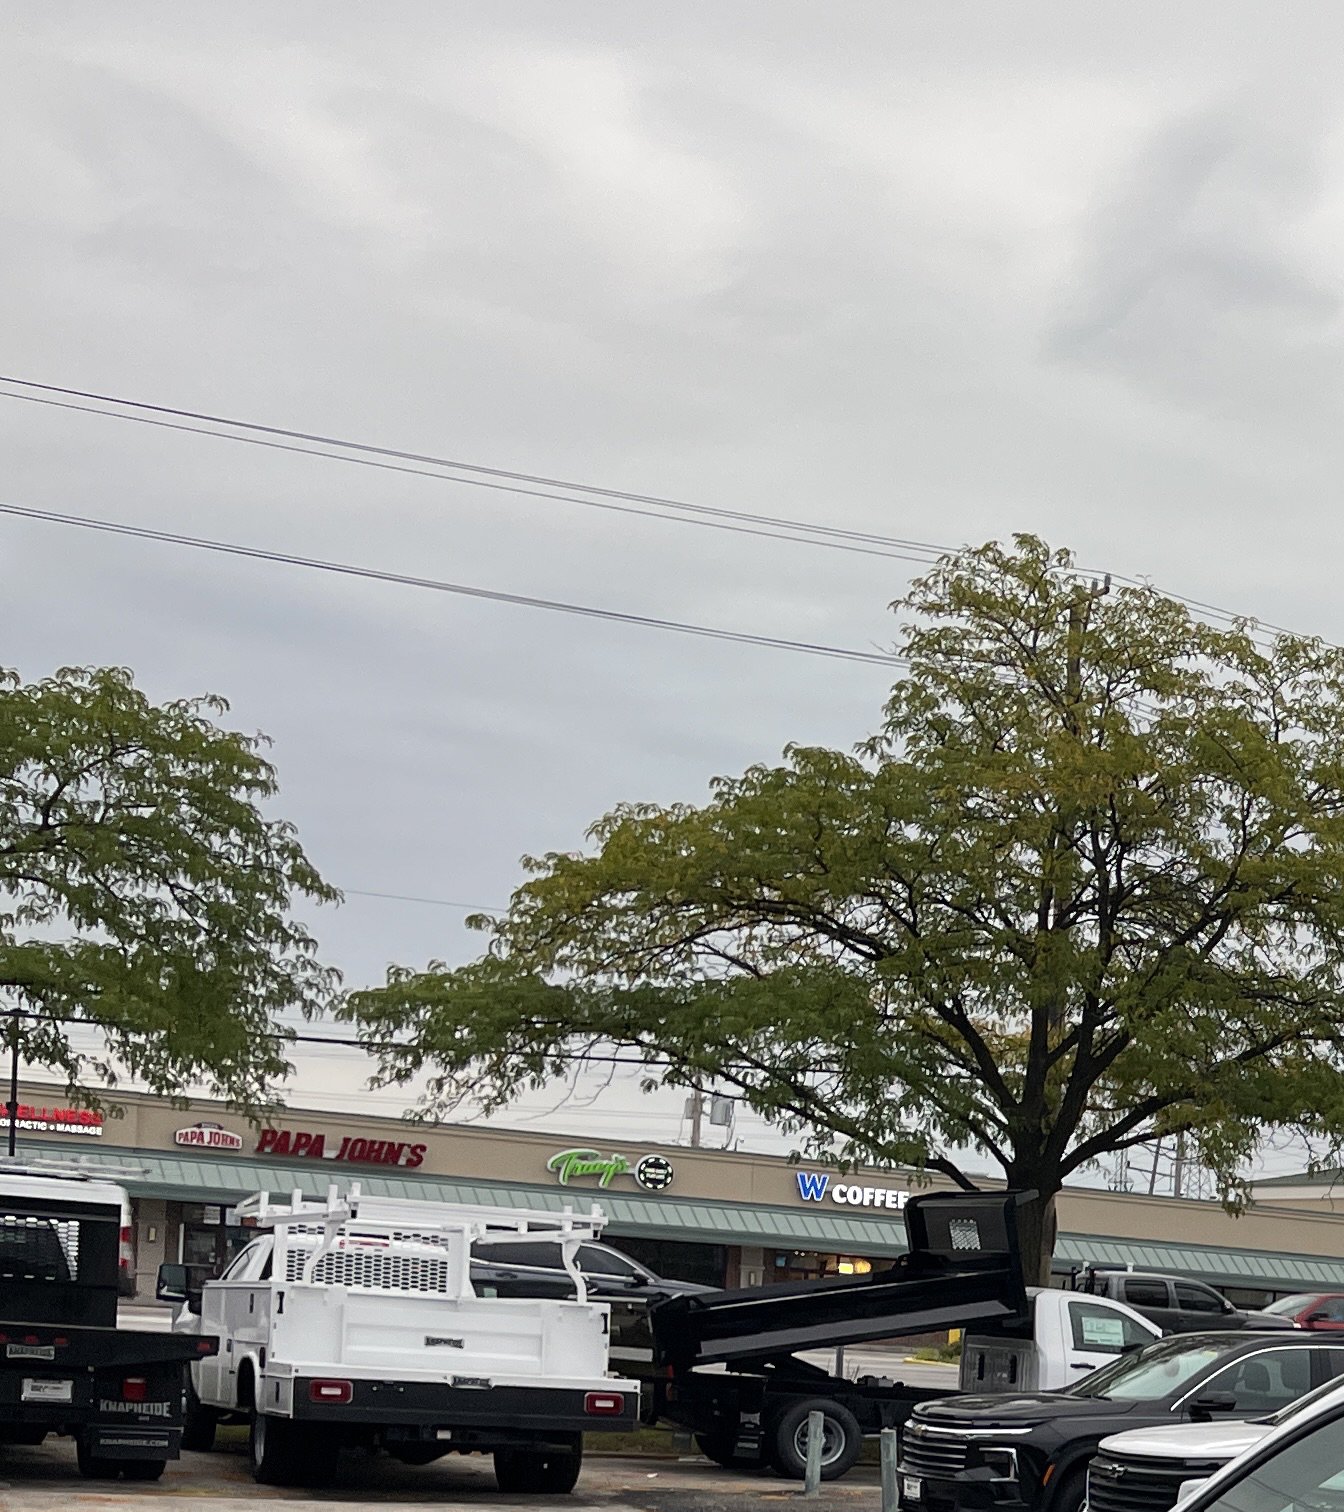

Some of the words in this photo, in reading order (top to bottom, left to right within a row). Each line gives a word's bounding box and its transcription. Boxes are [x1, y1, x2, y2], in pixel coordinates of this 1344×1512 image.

[56, 1124, 103, 1136] MASSAGE
[178, 1131, 205, 1145] PAPA
[257, 1129, 325, 1158] PAPA
[334, 1137, 427, 1167] JOHN'S
[797, 1172, 829, 1202] W
[100, 1399, 172, 1418] KNAPHEIDE
